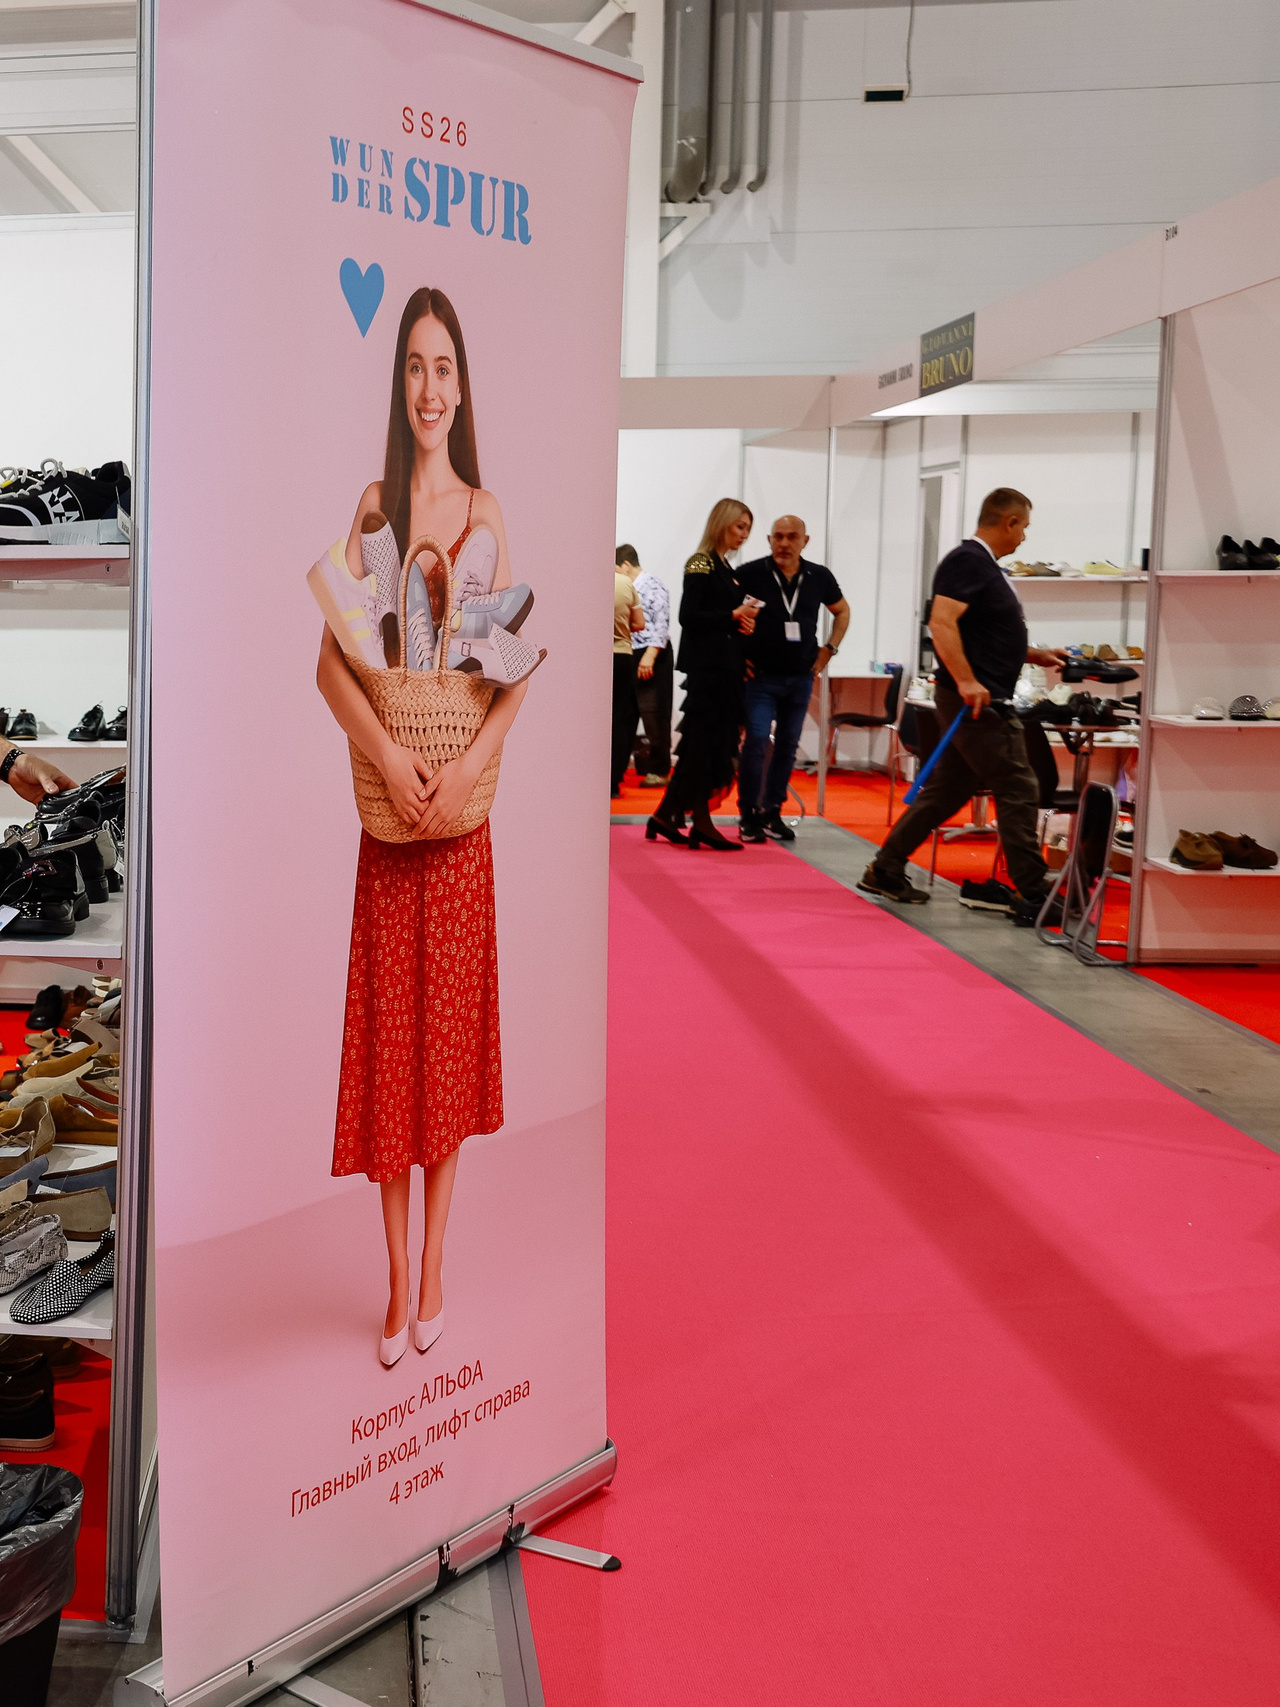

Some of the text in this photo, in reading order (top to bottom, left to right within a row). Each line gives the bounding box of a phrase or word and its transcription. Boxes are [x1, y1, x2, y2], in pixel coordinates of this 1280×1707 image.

[401, 106, 467, 147] SS26
[329, 136, 394, 179] WUN
[331, 172, 394, 215] DER
[404, 157, 532, 246] SPUR
[922, 347, 973, 389] BRUNO
[351, 1360, 484, 1444] Корпус АЛЬФА
[291, 1380, 531, 1518] Главный вход, лифт справа
[389, 1461, 445, 1505] 4 этаж
